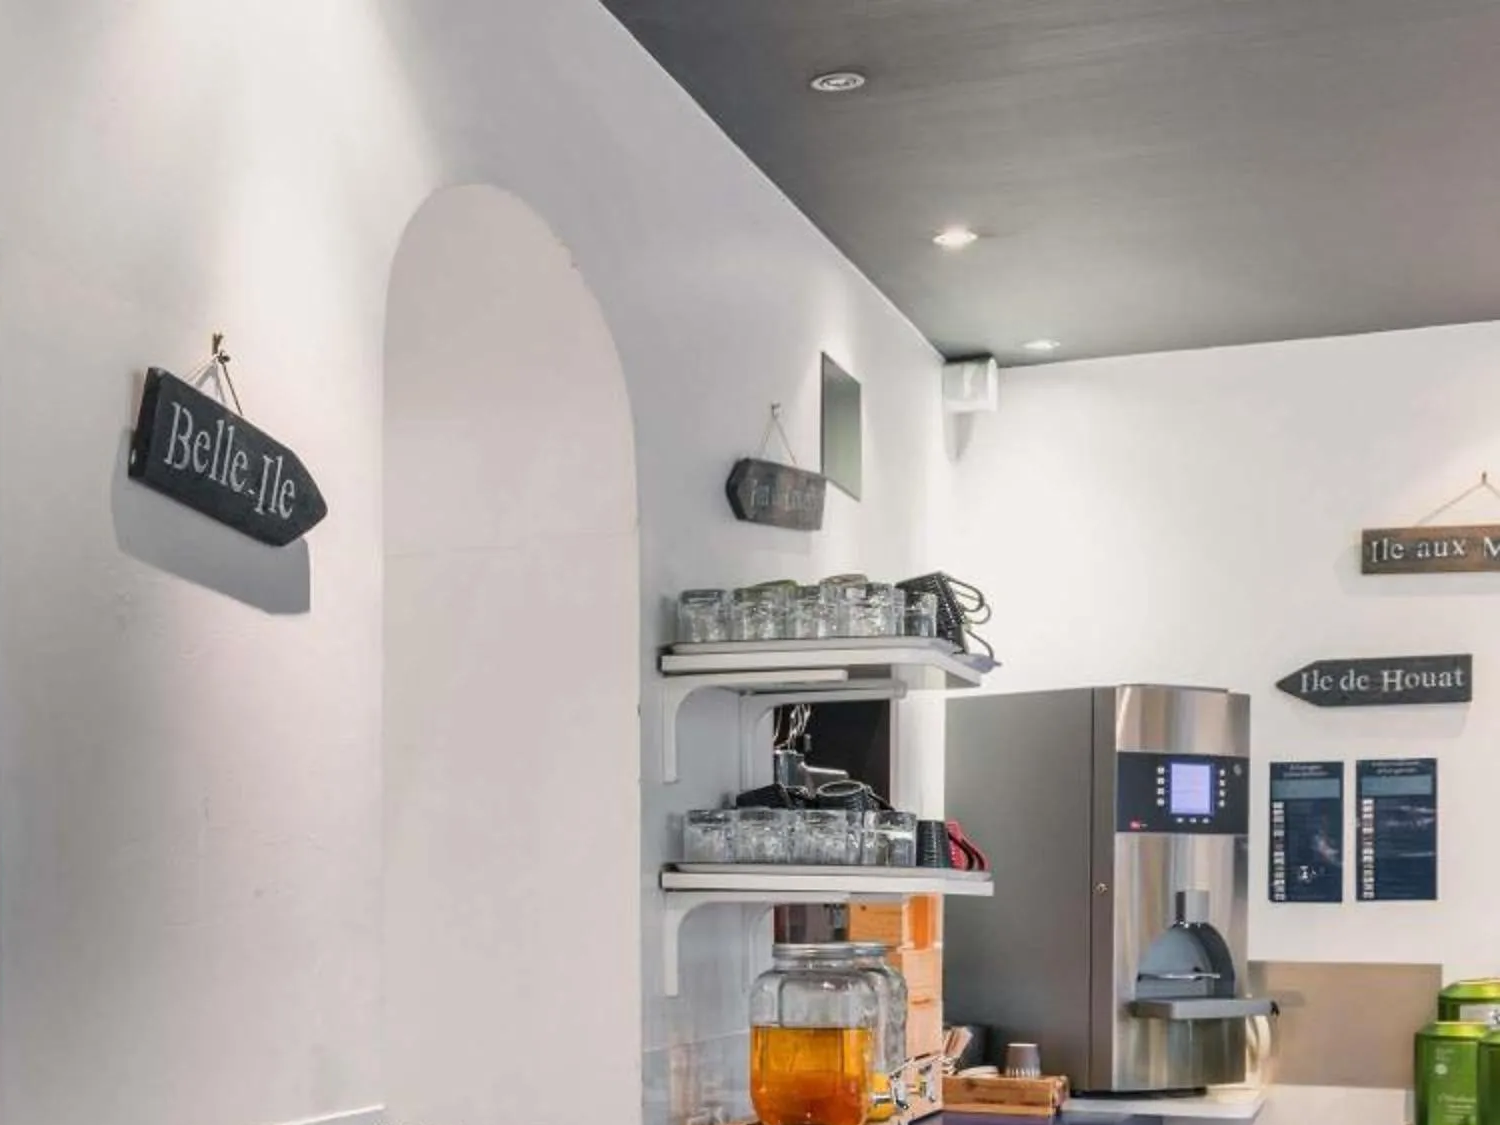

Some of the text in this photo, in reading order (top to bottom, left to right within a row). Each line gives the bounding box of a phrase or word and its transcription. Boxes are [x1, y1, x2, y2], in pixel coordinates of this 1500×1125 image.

[1371, 537, 1404, 563] Ile
[1416, 539, 1466, 558] aux
[1300, 664, 1466, 693] Ile de Houat
